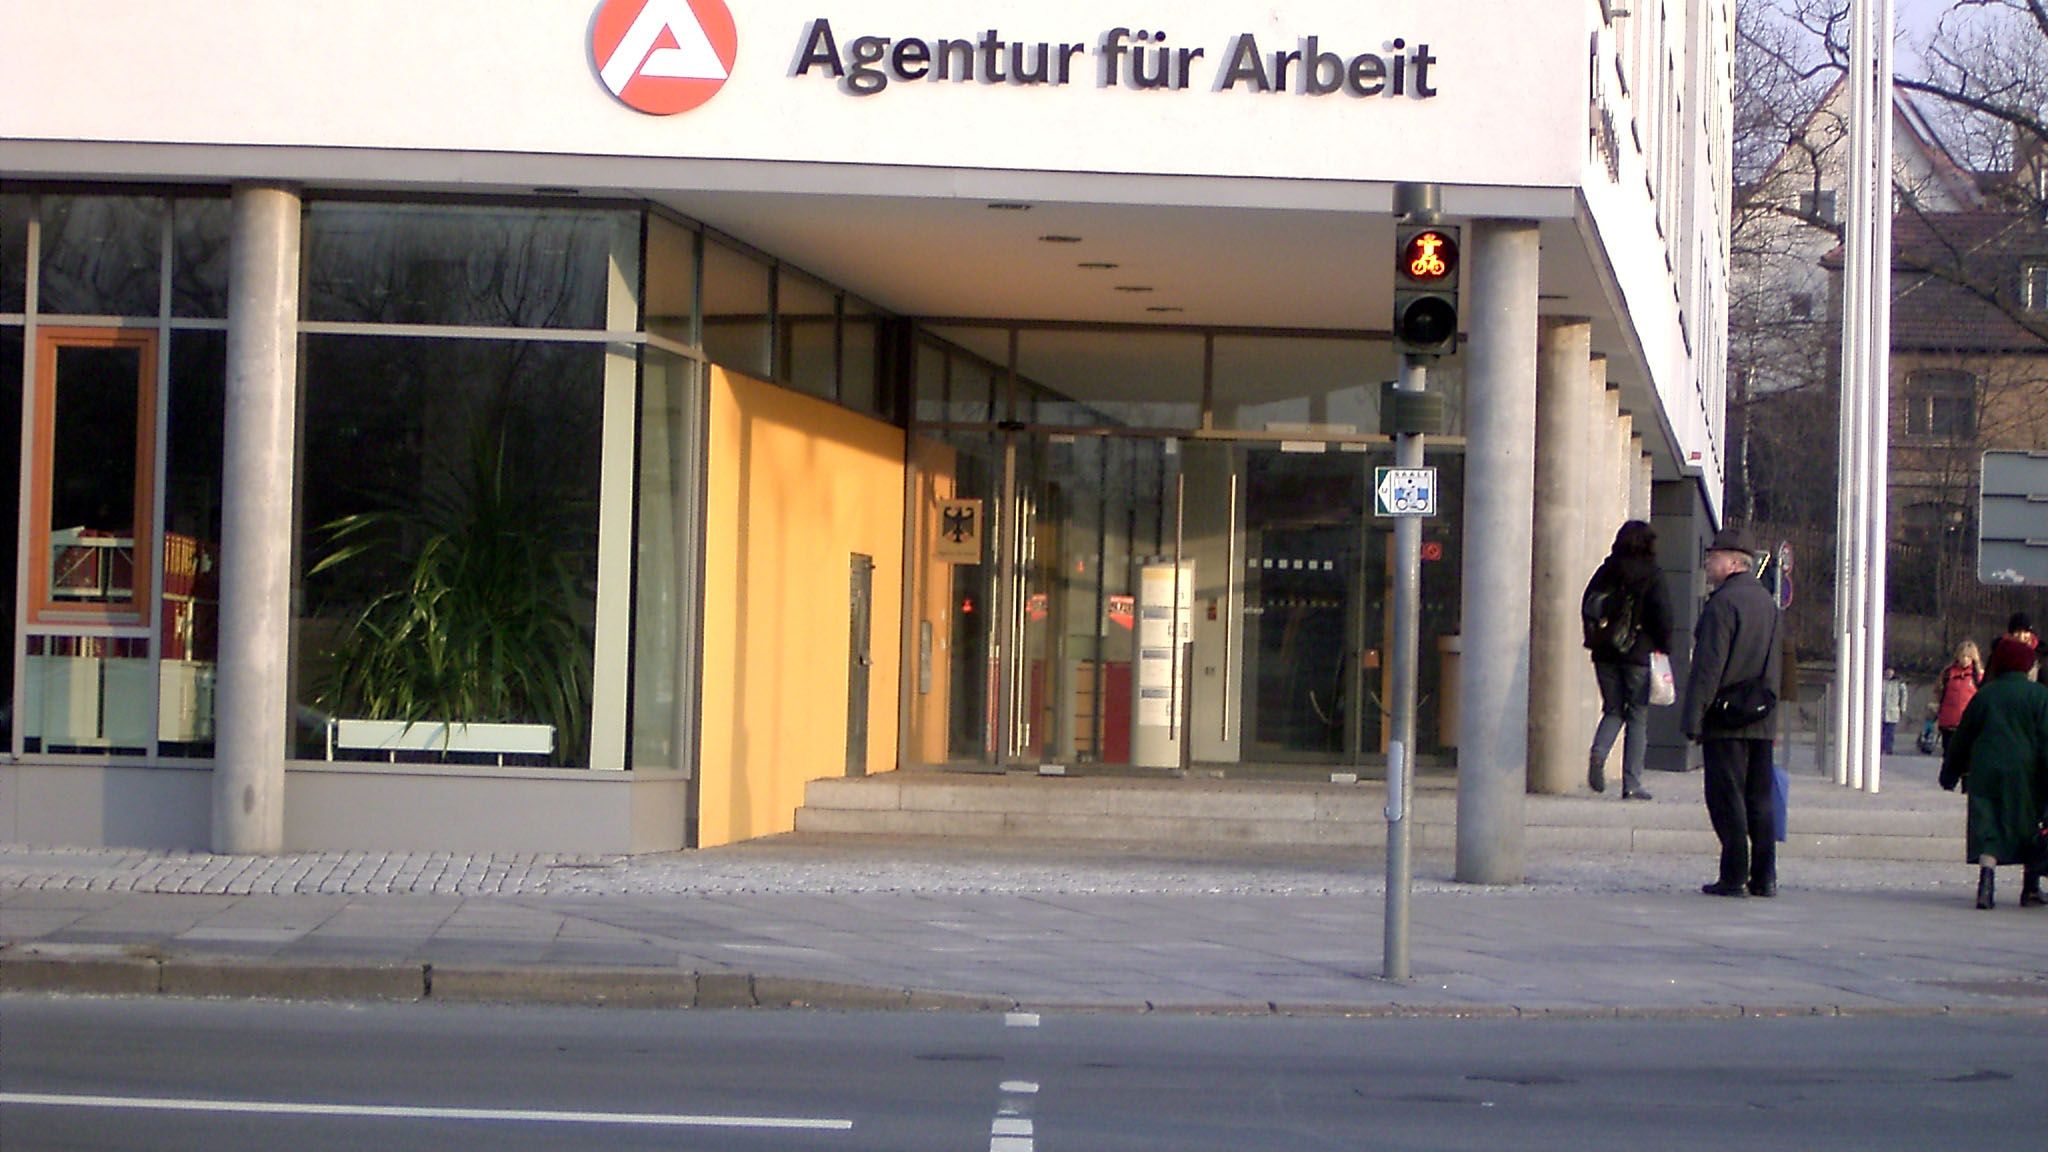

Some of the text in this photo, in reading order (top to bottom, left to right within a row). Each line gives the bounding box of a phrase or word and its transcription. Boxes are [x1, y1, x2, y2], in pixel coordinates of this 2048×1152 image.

[794, 18, 1437, 97] Agentur für Arbeit
